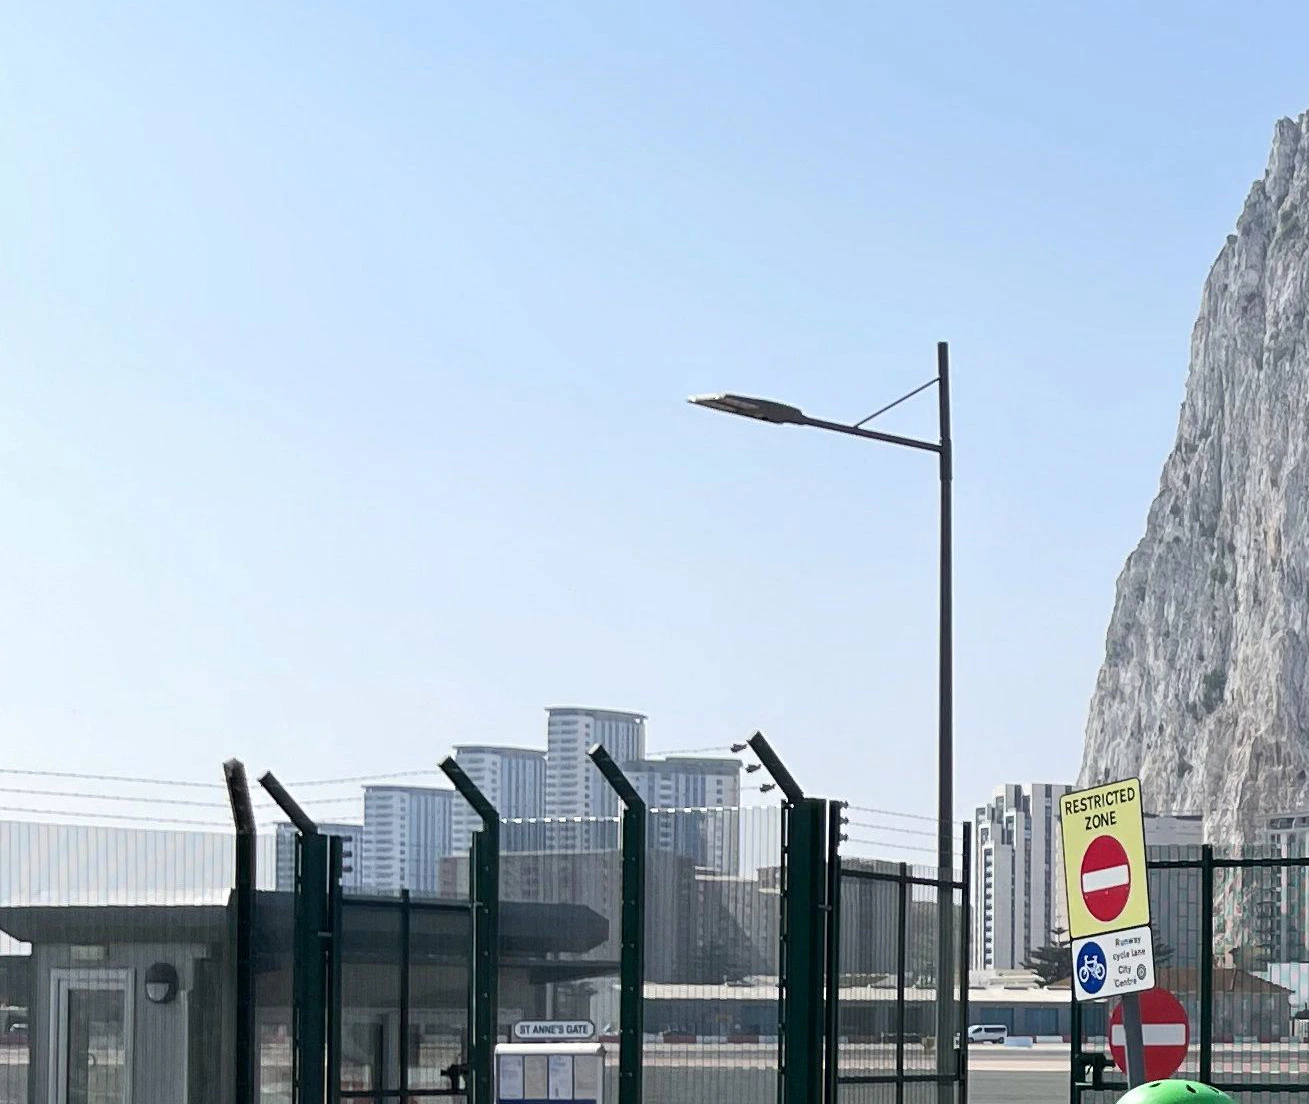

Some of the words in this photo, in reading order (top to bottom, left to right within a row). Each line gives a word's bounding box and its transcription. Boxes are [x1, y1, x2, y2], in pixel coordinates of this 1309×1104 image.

[1065, 787, 1135, 816] RESTRICTED
[1085, 811, 1117, 830] ZONE
[520, 1025, 530, 1034] ST
[533, 1025, 564, 1034] ANNE'S
[566, 1025, 588, 1034] GATE
